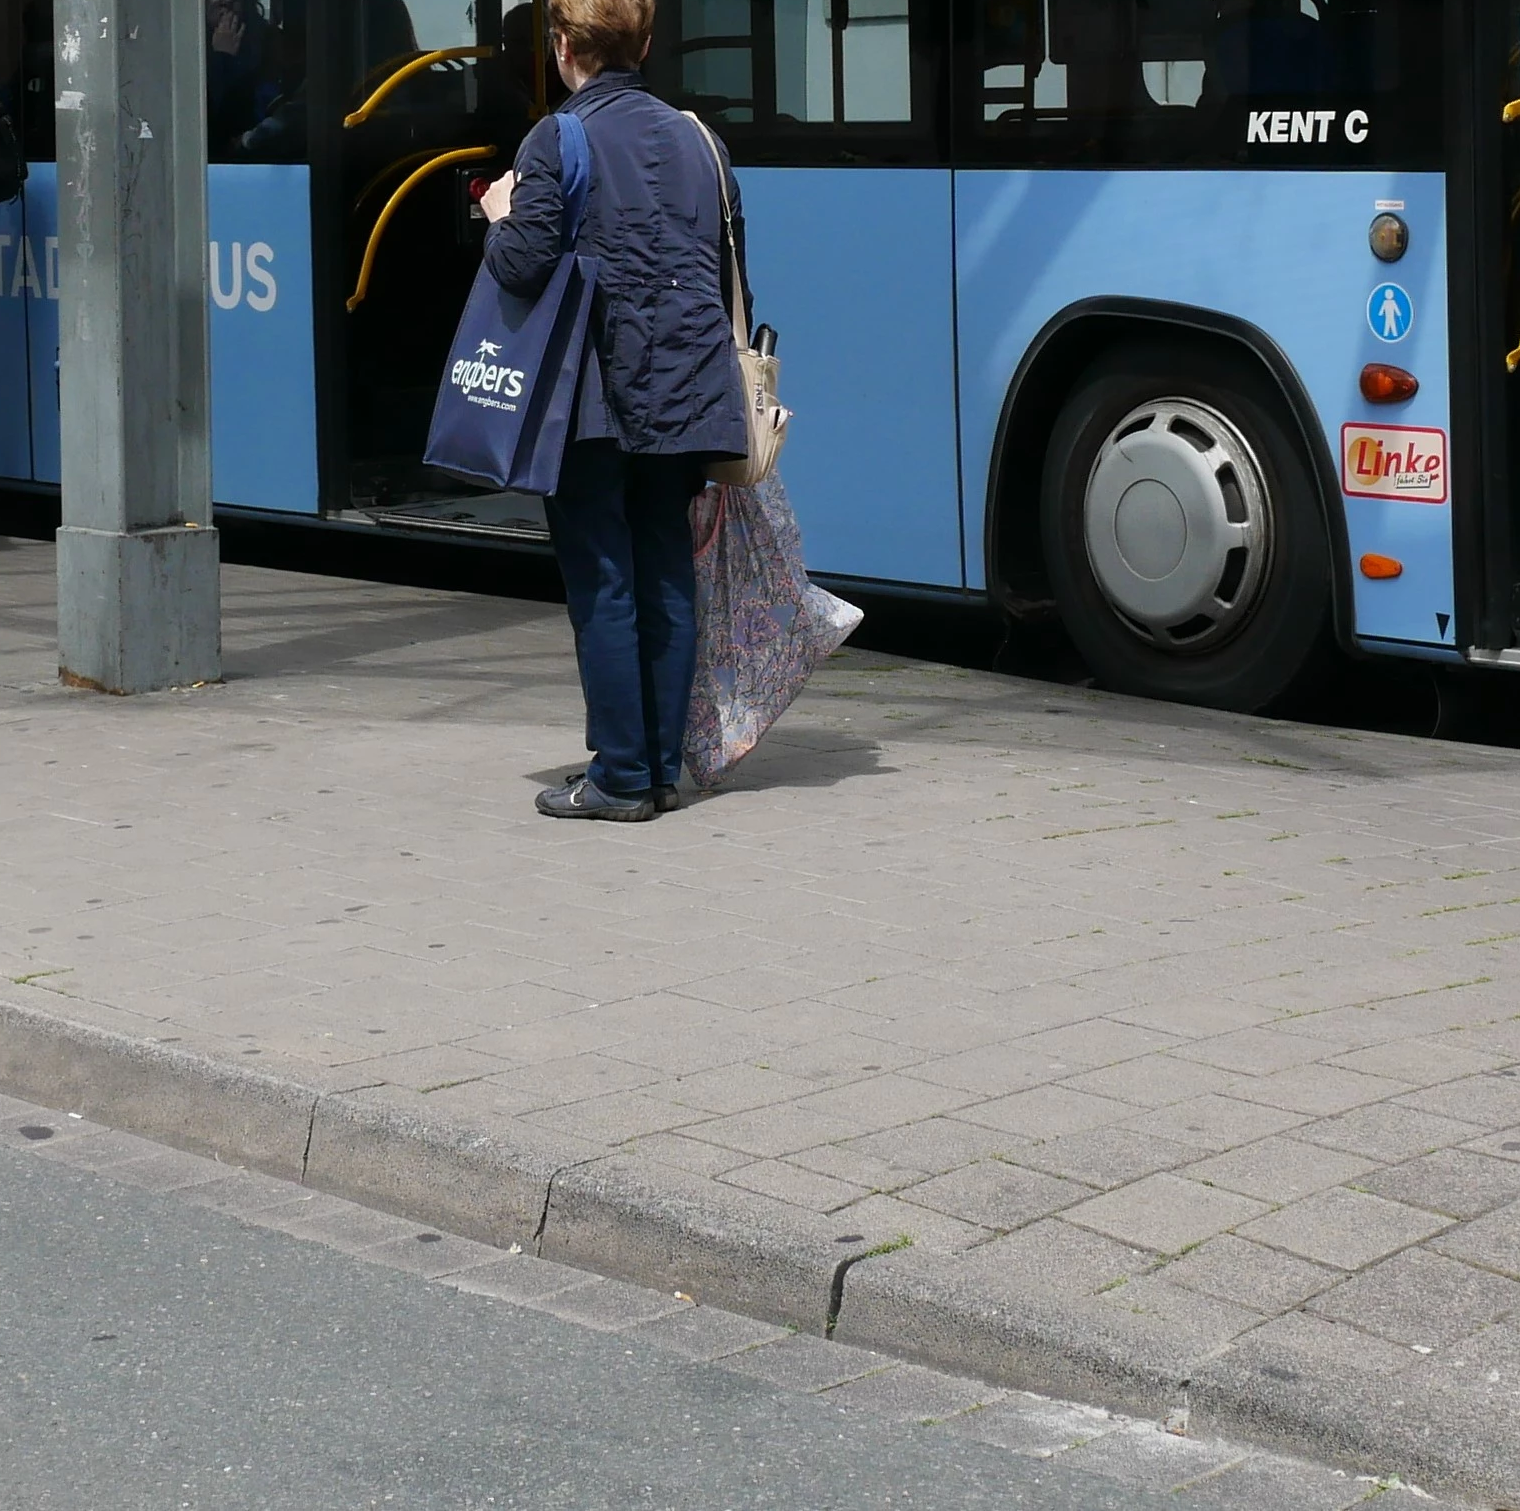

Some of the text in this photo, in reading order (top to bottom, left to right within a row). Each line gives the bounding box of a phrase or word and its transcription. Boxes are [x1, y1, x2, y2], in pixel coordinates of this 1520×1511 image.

[1247, 109, 1369, 143] KENT C
[209, 241, 277, 312] US
[451, 353, 524, 397] engbers
[467, 395, 517, 412] www.engbers.com
[1356, 440, 1440, 479] Linke
